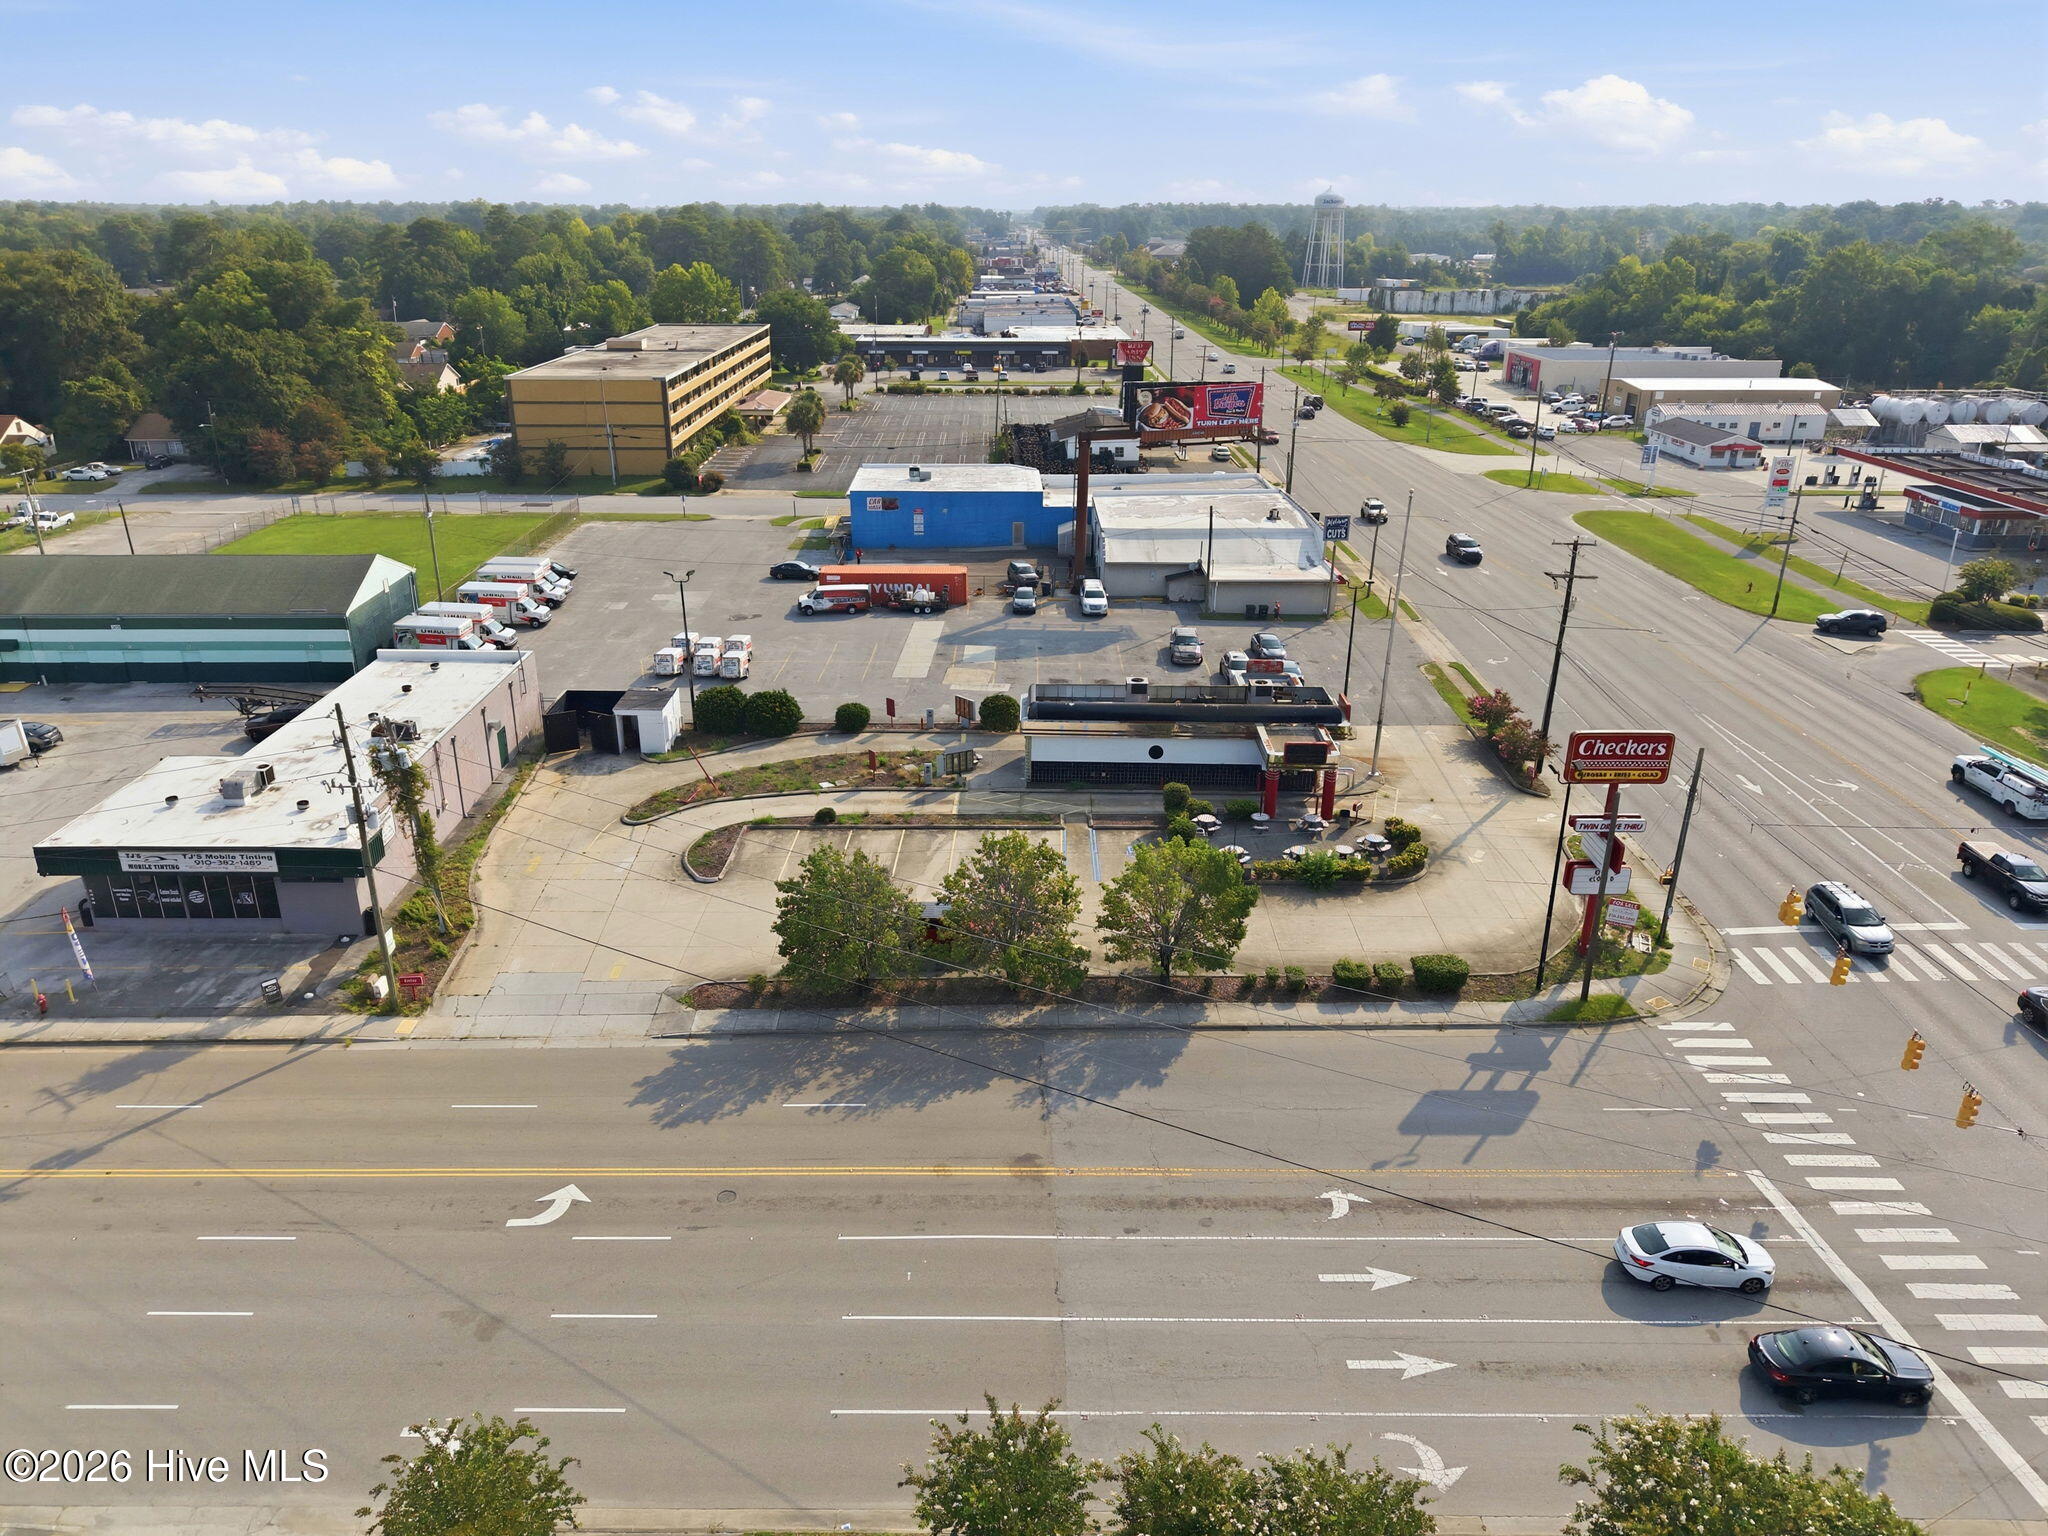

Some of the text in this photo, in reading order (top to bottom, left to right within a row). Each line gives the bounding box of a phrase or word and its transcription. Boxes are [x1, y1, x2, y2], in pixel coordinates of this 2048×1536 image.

[1326, 529, 1346, 539] CUTS
[869, 583, 931, 594] YUNDAI
[1578, 738, 1668, 757] Checkers
[1579, 823, 1644, 831] TWIN DRVE THRU
[239, 853, 273, 861] Tinting
